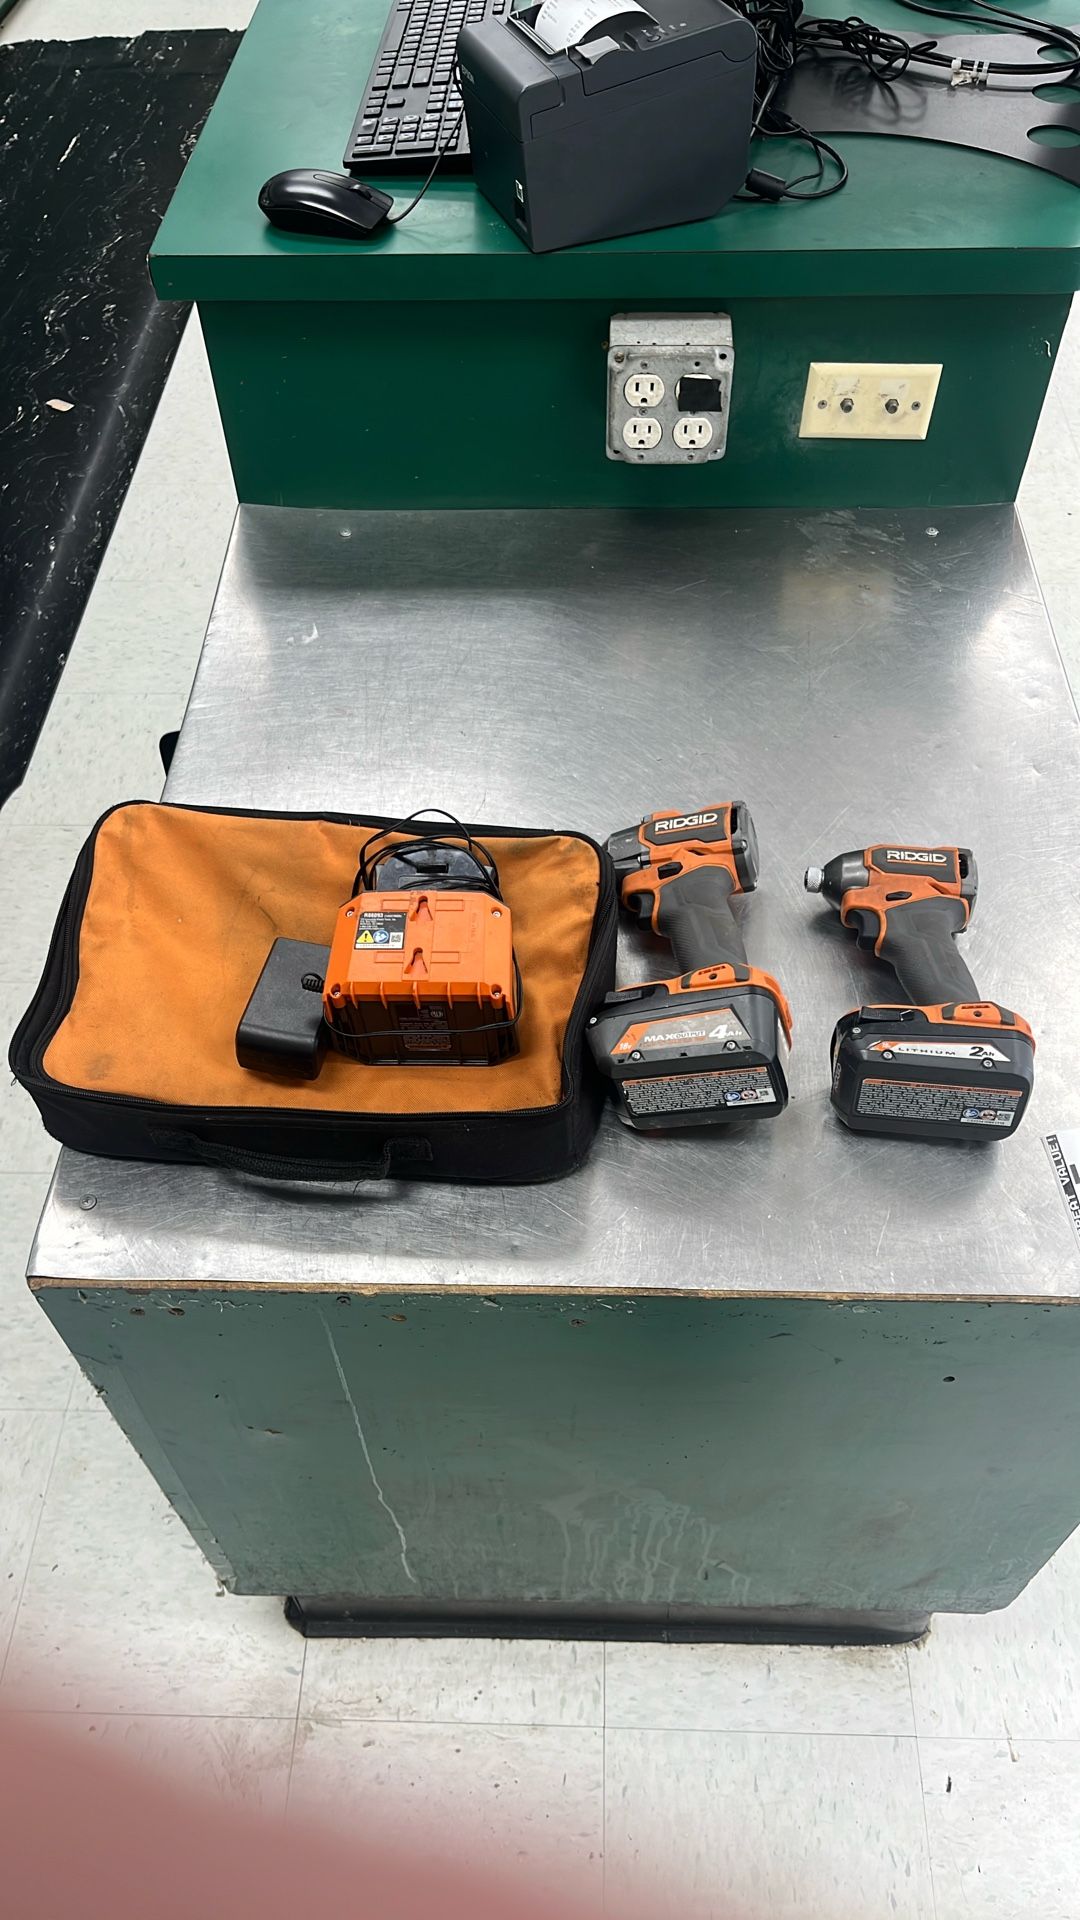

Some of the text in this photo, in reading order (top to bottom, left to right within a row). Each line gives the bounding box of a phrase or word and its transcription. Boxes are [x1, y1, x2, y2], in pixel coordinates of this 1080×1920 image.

[655, 813, 718, 832] RIDGID
[886, 850, 947, 863] RIDGID
[898, 1047, 957, 1056] LITHIUM
[1046, 1136, 1072, 1186] VALUE!
